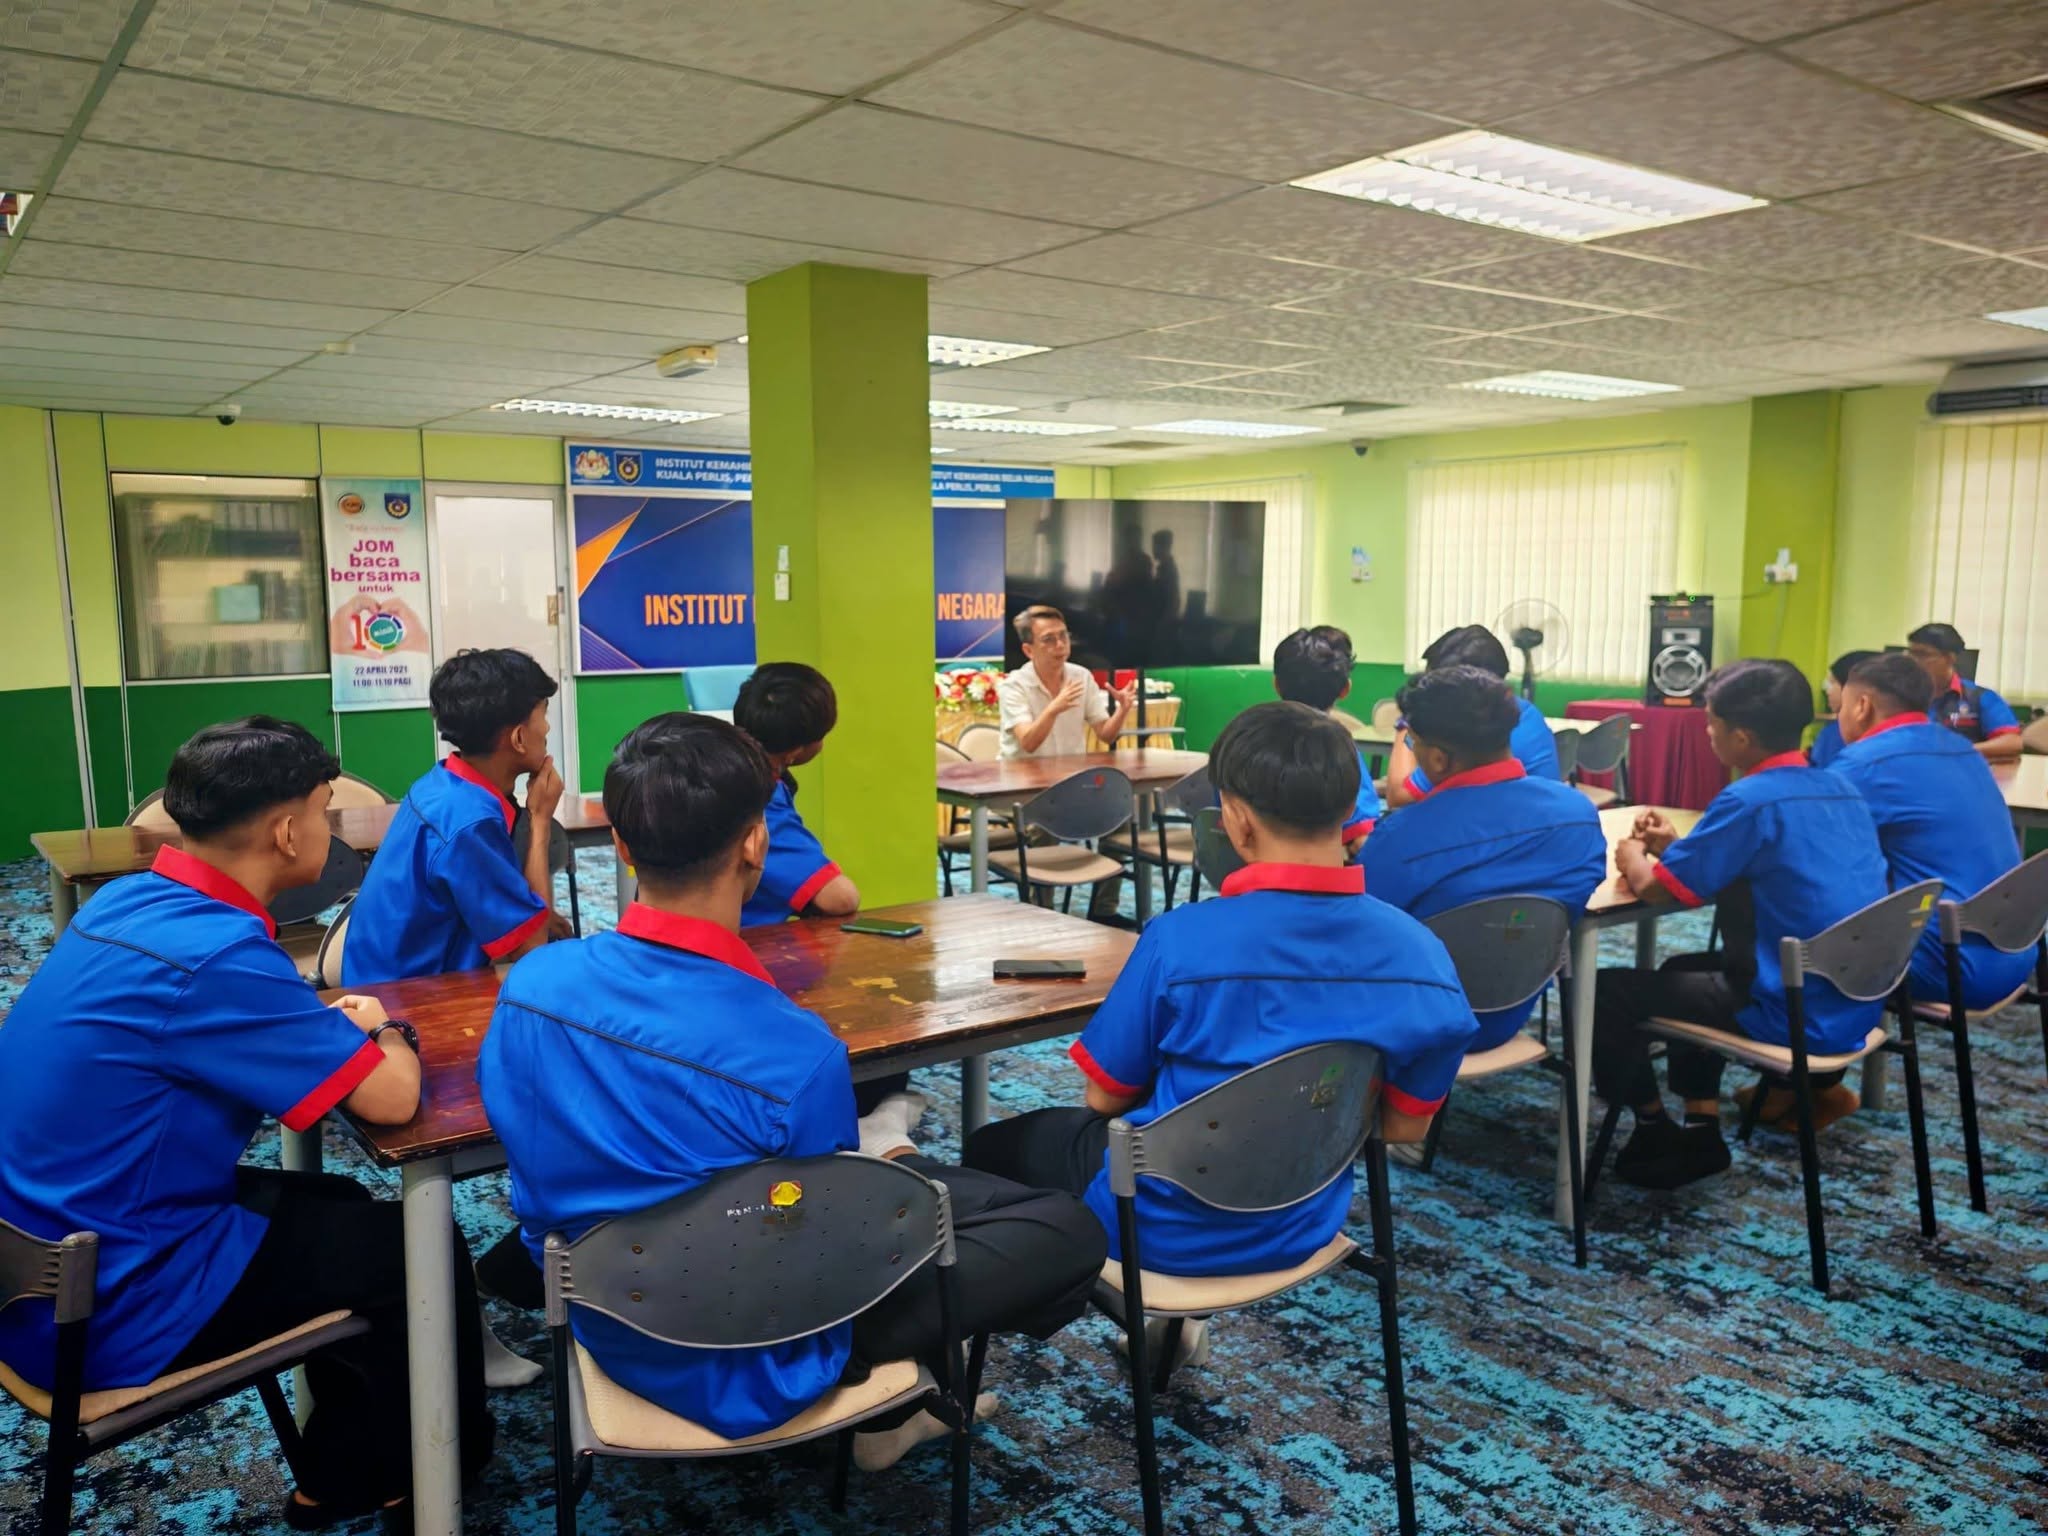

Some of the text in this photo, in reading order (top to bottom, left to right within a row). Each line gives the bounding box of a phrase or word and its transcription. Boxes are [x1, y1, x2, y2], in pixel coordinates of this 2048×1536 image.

[655, 458, 704, 470] INSTITUT
[656, 470, 694, 481] KUALA
[353, 540, 394, 552] JOM
[349, 553, 400, 568] baca
[330, 567, 421, 582] bersama
[358, 584, 394, 593] untuk
[645, 594, 747, 626] INSTITUT
[937, 592, 1005, 621] NEGARA
[365, 666, 387, 674] APRIL
[394, 678, 412, 686] PAGI
